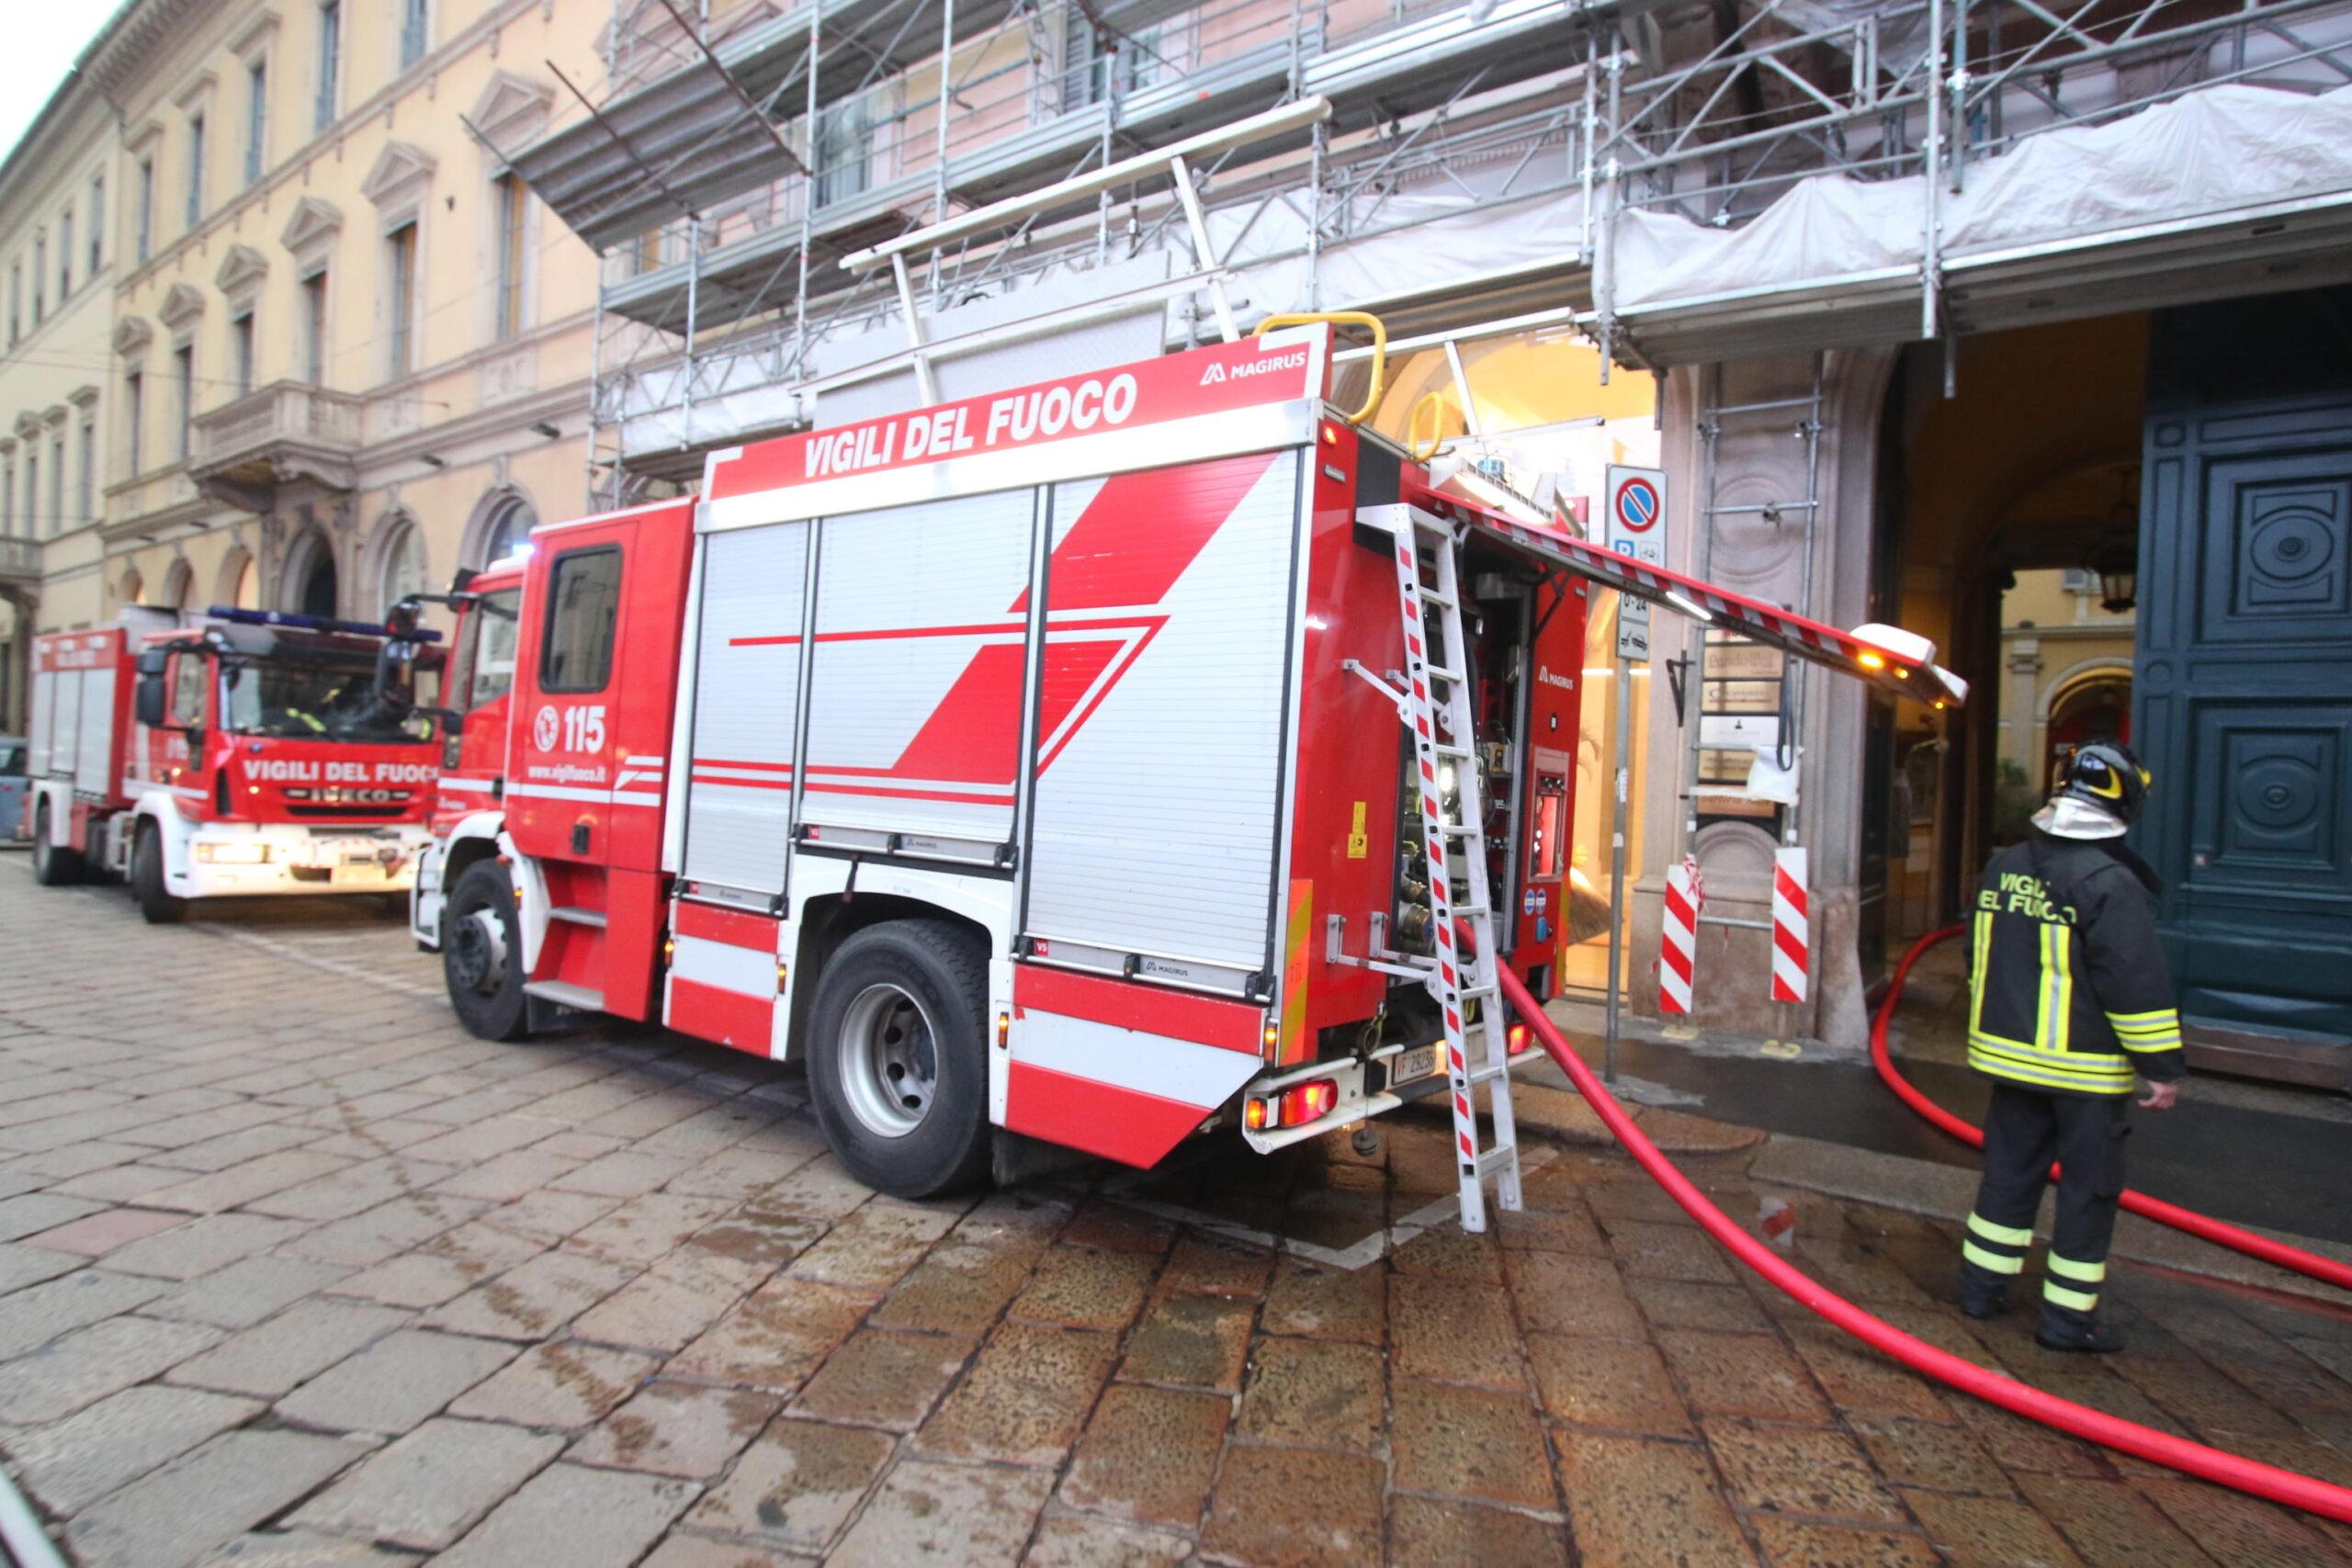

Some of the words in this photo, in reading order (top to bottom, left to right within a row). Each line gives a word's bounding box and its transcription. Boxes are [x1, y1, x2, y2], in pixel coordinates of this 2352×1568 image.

[1230, 352, 1306, 380] MAGIRUS
[805, 422, 897, 478] VIGILI
[902, 407, 974, 460] DEL
[985, 373, 1138, 446] FUOCO
[1549, 672, 1573, 691] MAGIRUS
[564, 705, 606, 755] 115
[243, 760, 320, 781] VIGILI
[325, 761, 370, 782] DEL
[1978, 889, 2002, 910] EL
[1158, 965, 1189, 976] MAGIRUS
